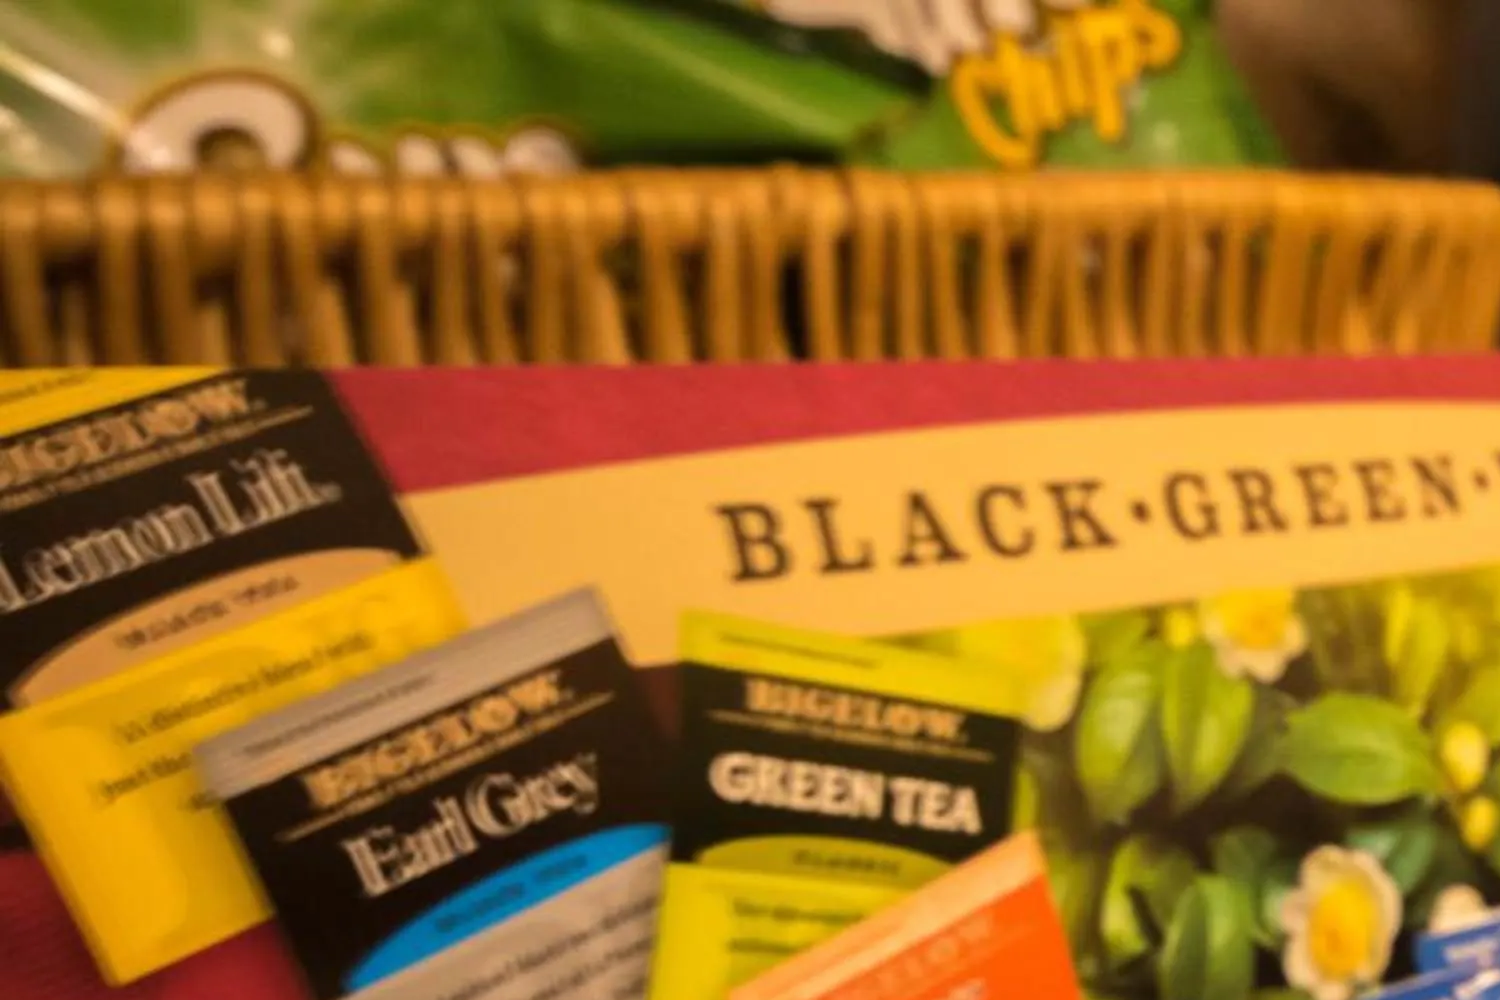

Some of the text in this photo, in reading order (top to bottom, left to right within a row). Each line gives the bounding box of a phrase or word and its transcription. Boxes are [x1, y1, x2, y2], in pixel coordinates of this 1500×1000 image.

[719, 478, 1117, 583] BLACK
[1161, 454, 1463, 543] GREEN
[342, 796, 479, 897] Earl
[464, 753, 598, 841] Grey
[709, 750, 982, 835] GREEN TEA
